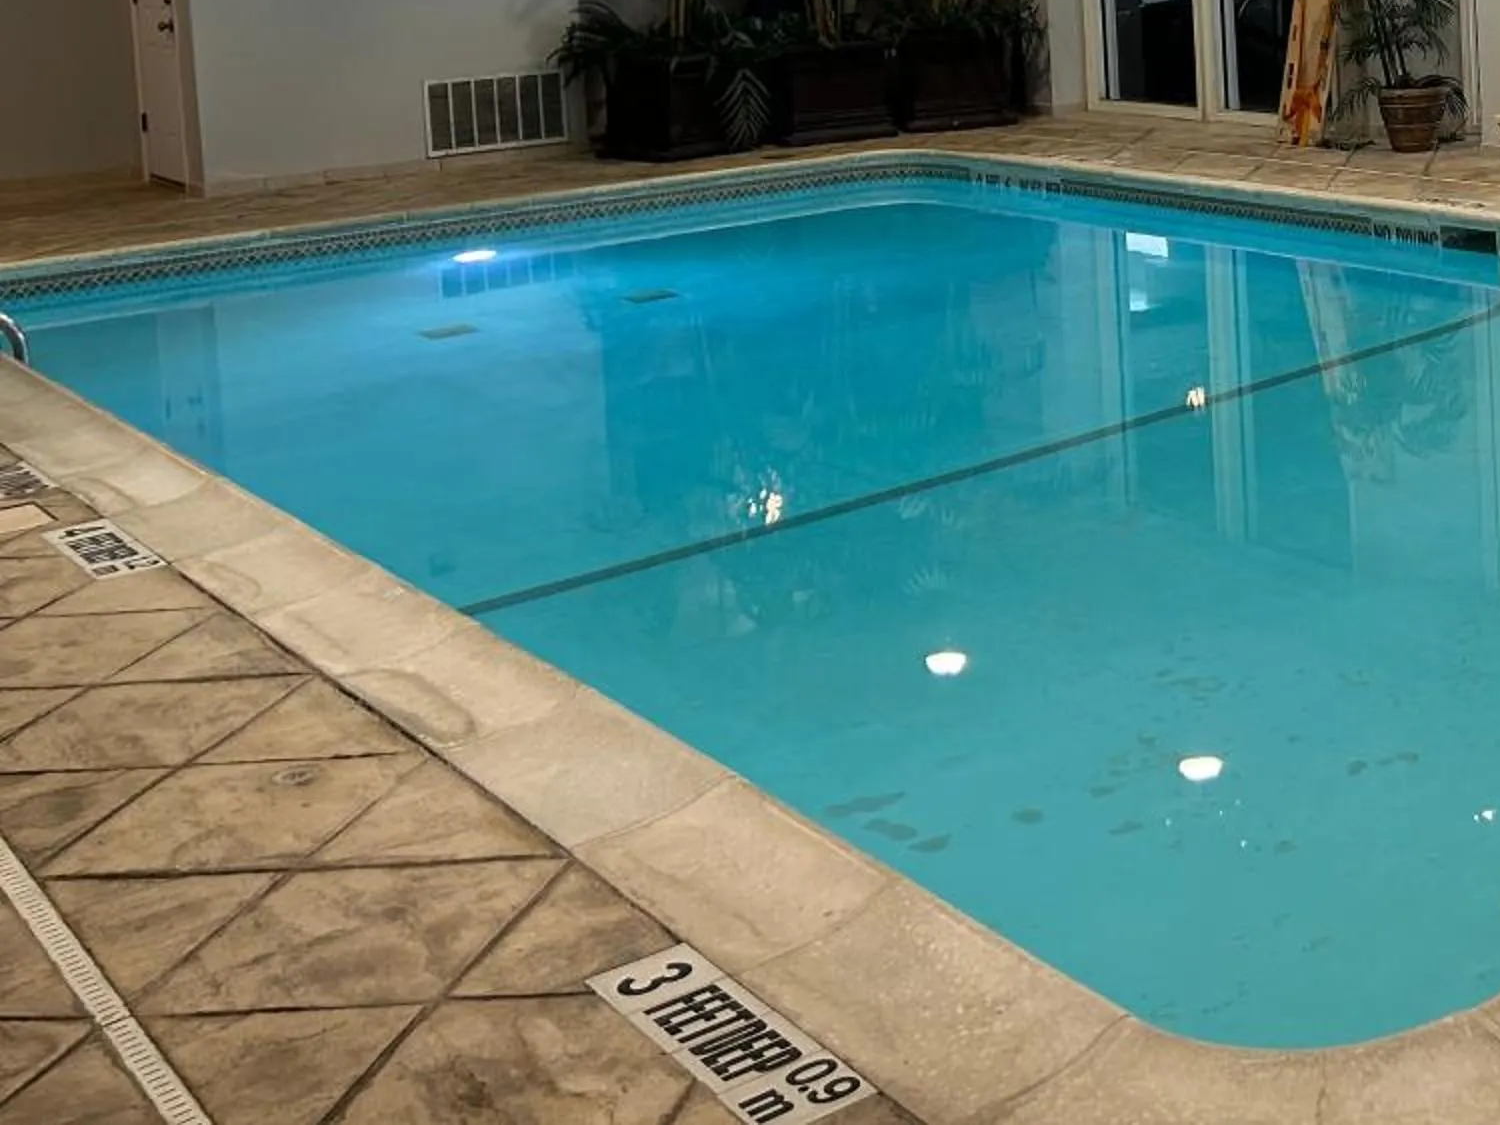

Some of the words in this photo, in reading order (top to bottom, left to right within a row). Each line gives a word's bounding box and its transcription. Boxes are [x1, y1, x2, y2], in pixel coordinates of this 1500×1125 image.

[617, 962, 693, 996] 3
[785, 1058, 861, 1104] 0.9
[738, 1088, 795, 1125] m
